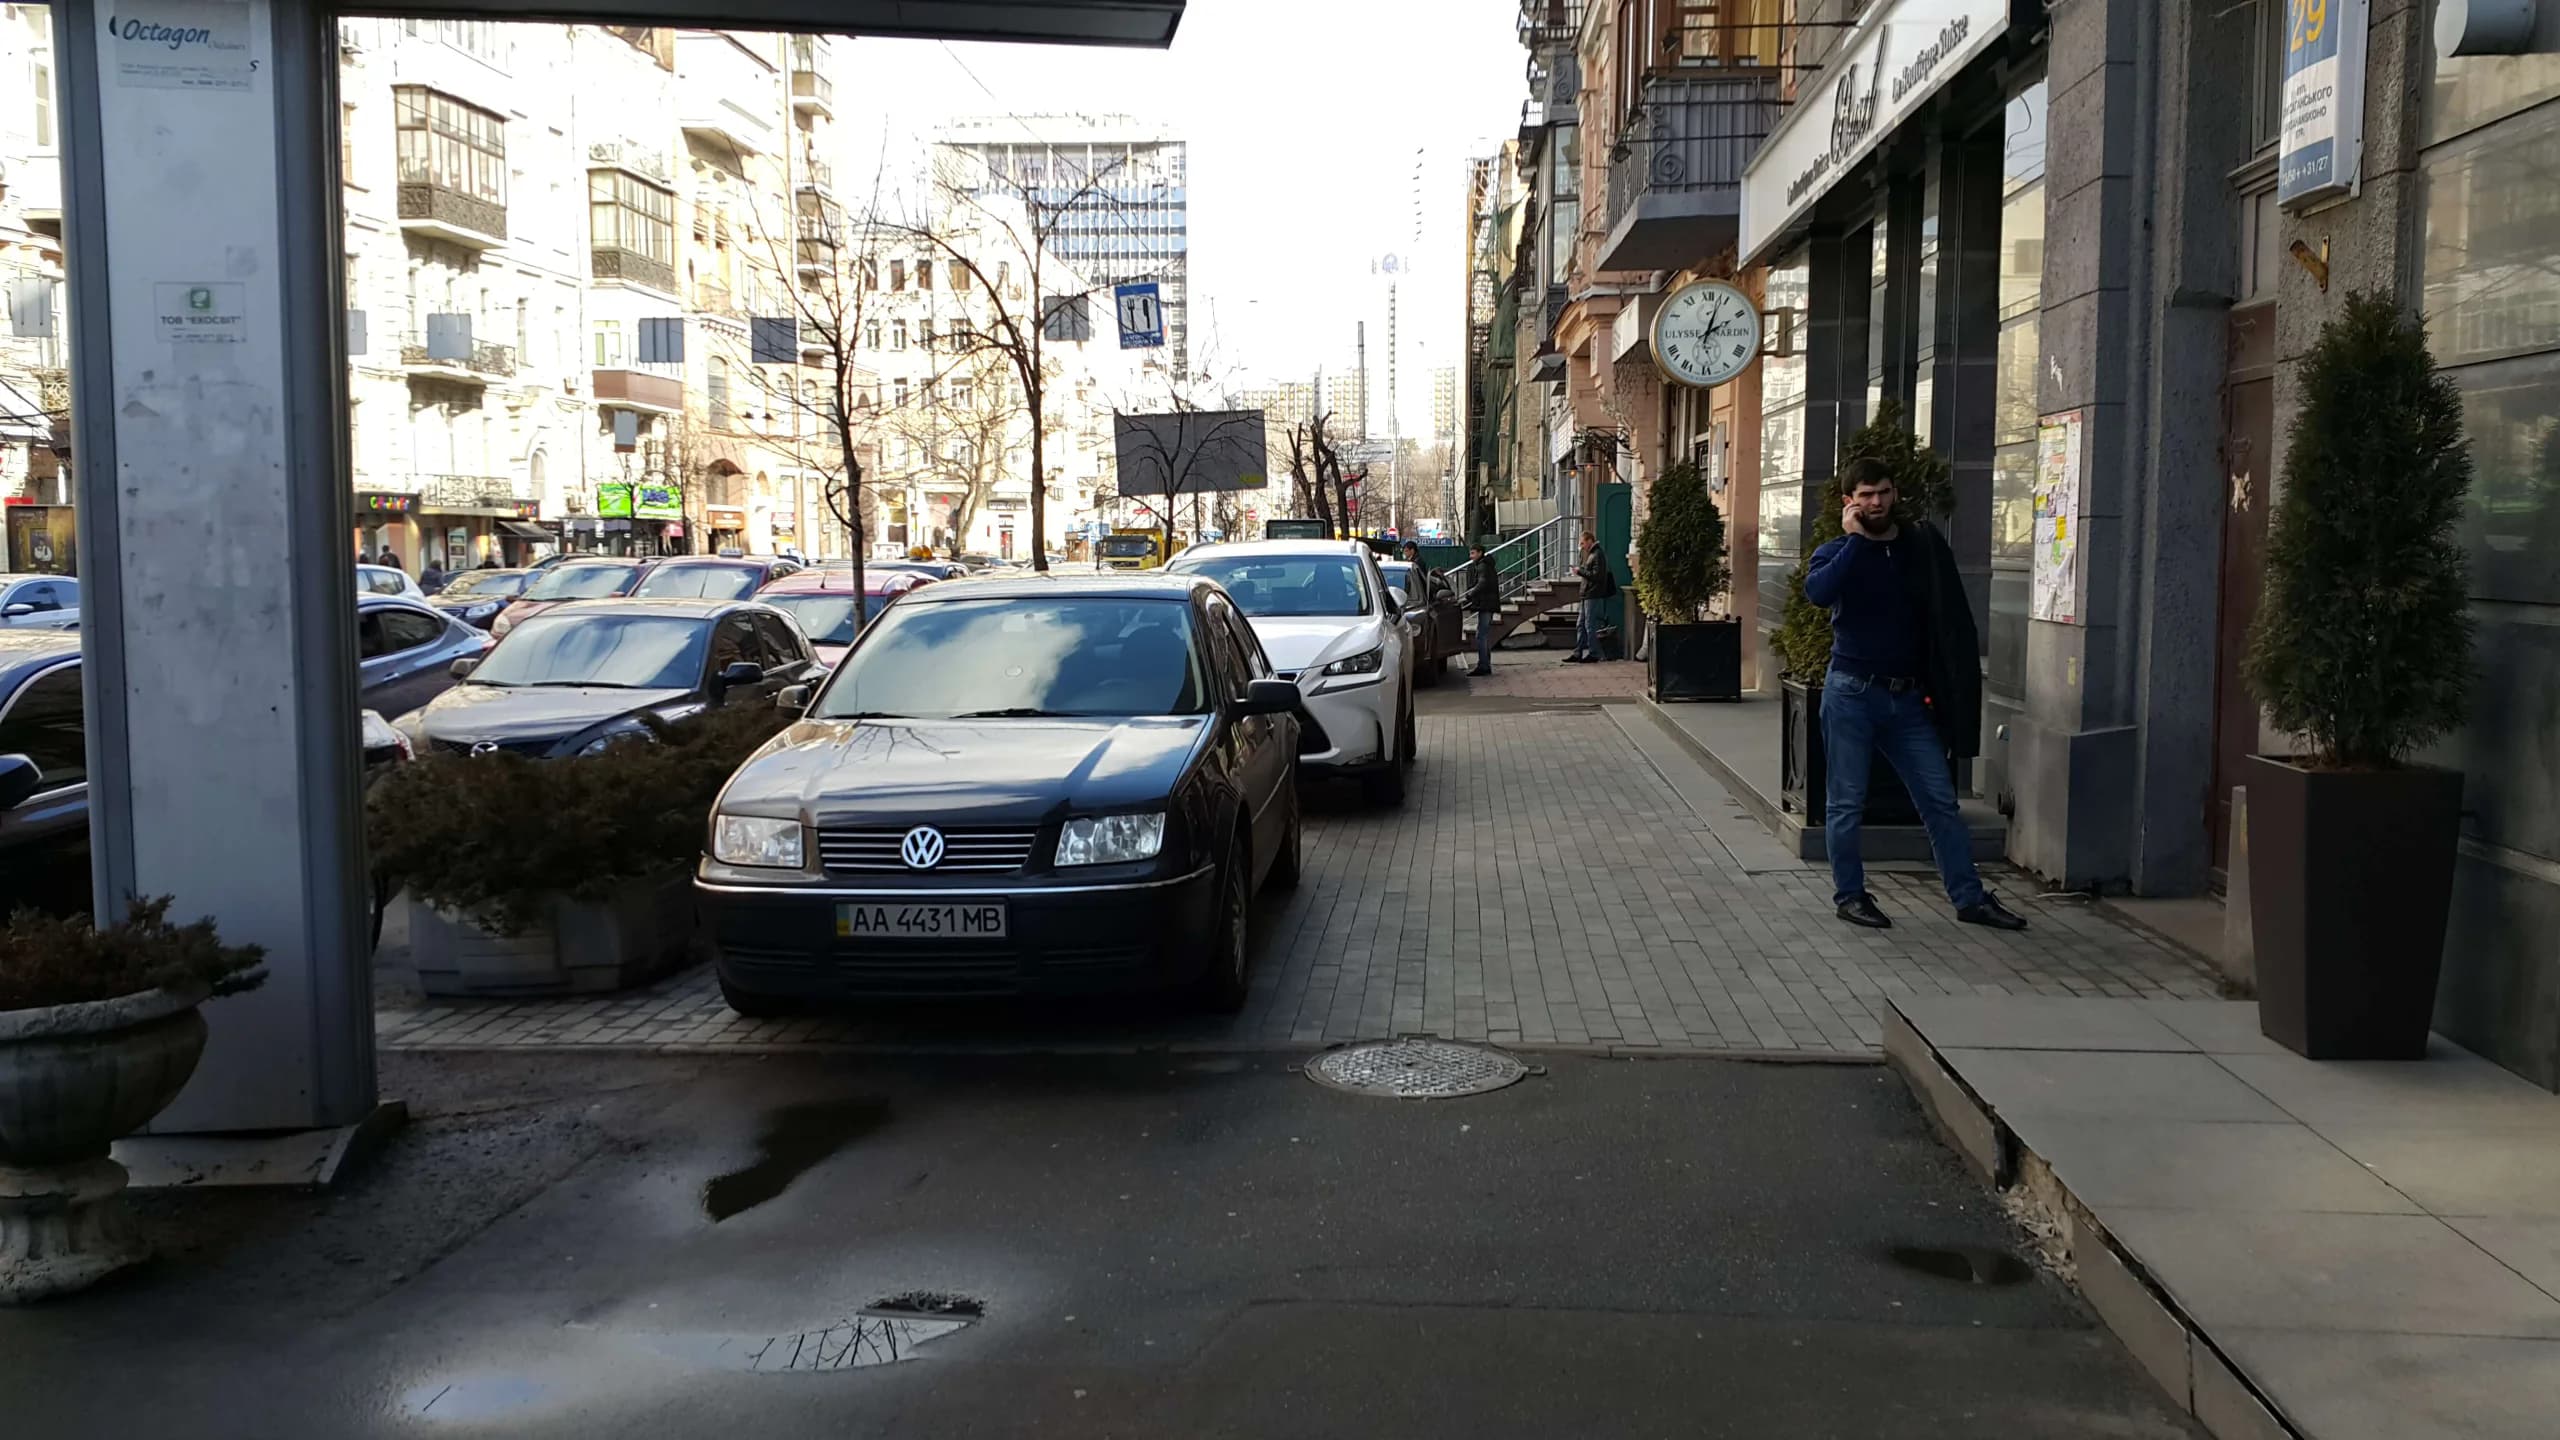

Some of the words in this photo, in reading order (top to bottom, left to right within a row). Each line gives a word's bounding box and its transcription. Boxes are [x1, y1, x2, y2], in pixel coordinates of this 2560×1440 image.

[122, 19, 210, 50] Octagon
[2290, 0, 2327, 54] 29
[1903, 44, 1938, 93] Boutique
[2307, 155, 2329, 176] 31/27
[1665, 330, 1700, 339] ULYSSE
[1714, 328, 1750, 337] NARDIN
[1412, 538, 1446, 546] ОДУКТИ
[853, 907, 889, 932] AA
[896, 907, 955, 932] 4431
[962, 907, 1001, 932] MB
